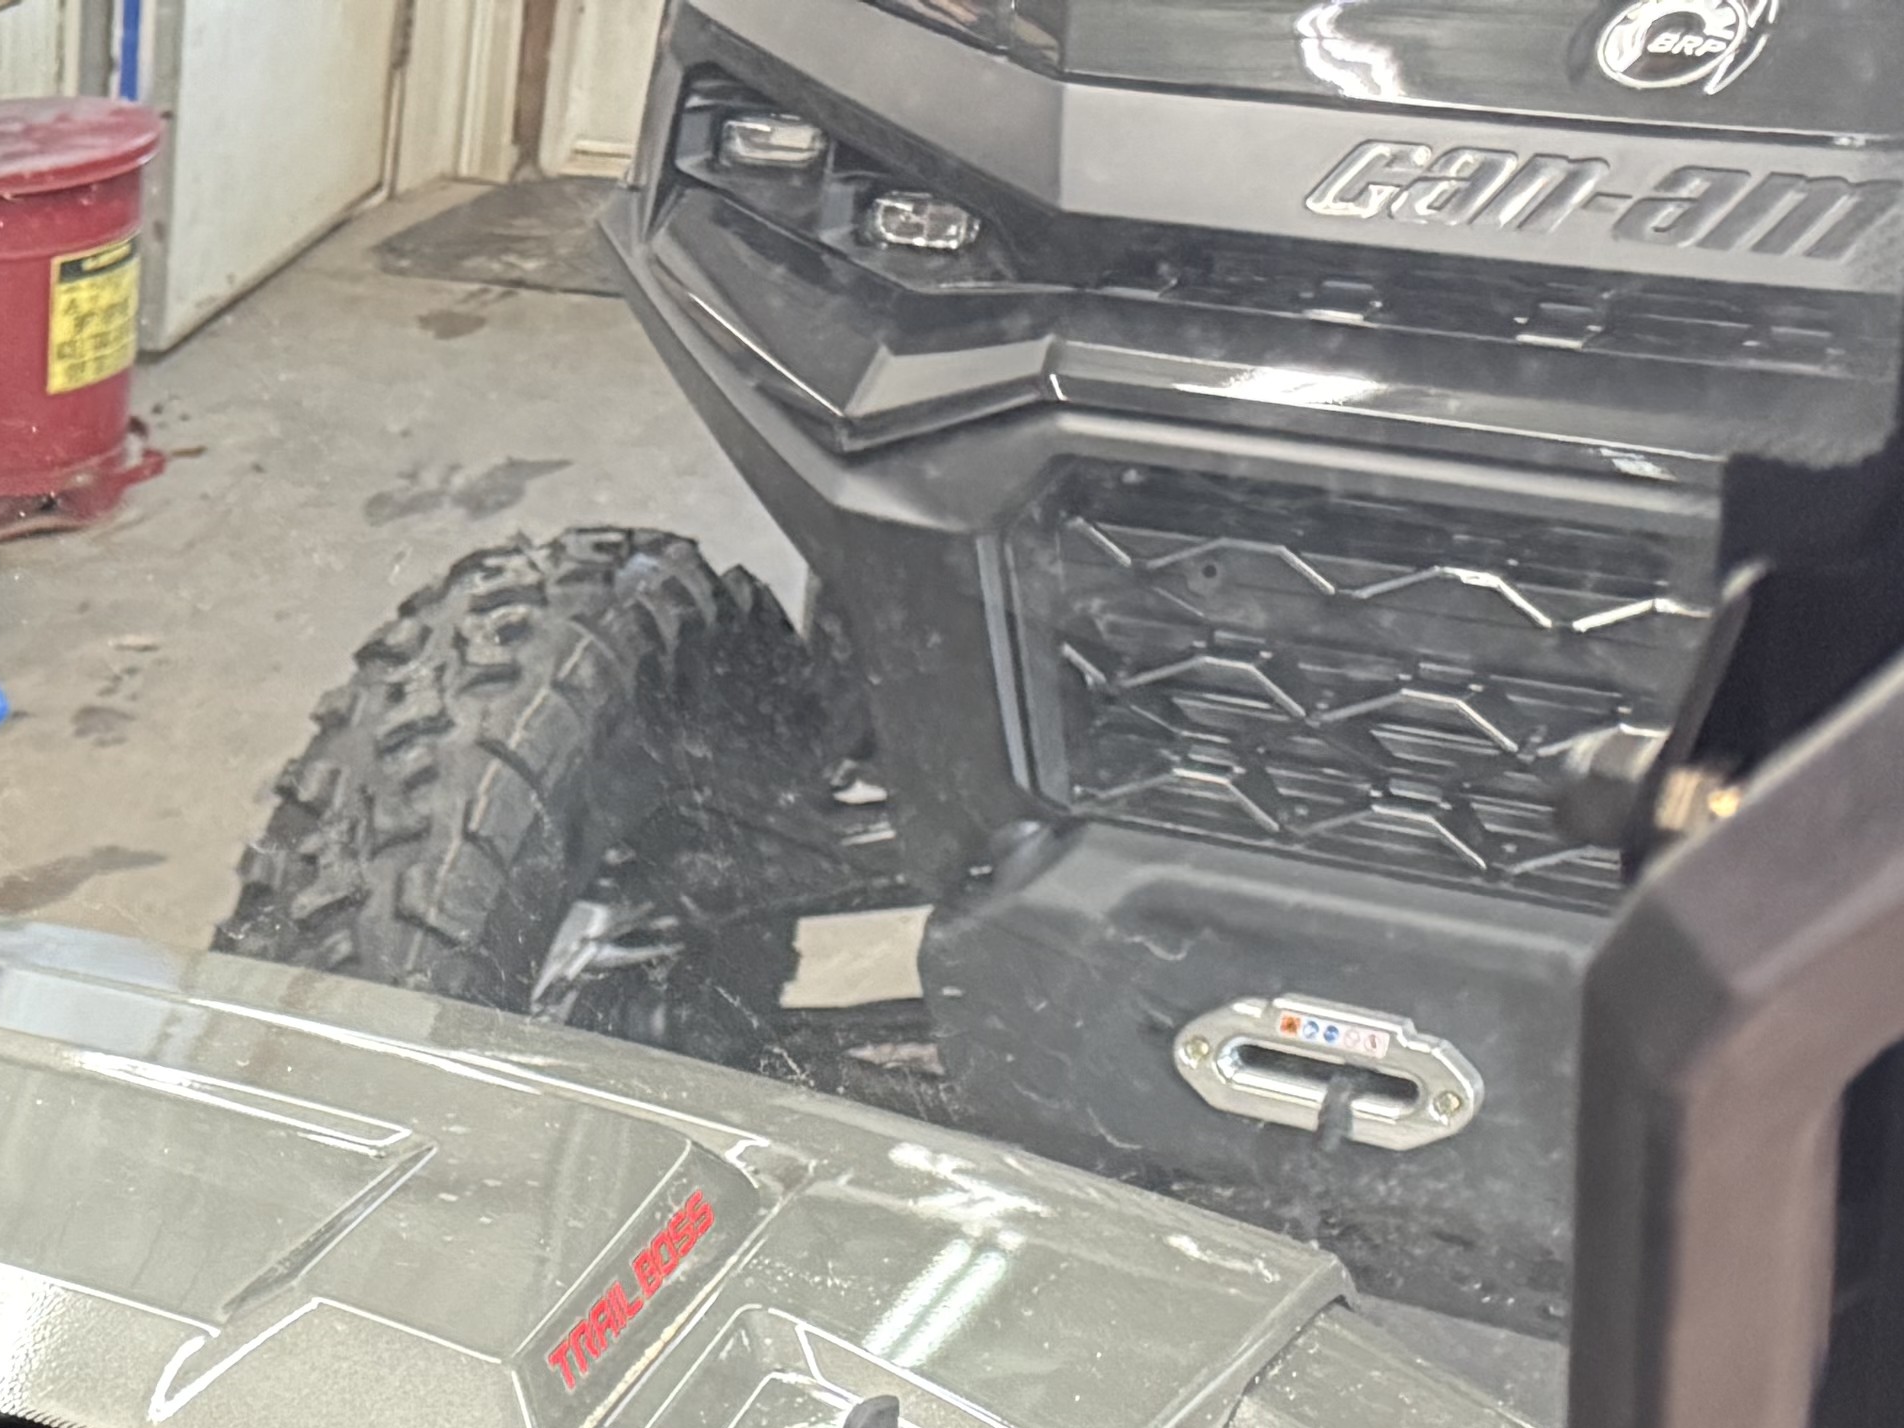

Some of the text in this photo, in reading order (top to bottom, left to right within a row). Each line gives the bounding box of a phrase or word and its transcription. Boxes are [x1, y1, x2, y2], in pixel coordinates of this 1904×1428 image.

[1648, 32, 1727, 57] BRP
[547, 1189, 715, 1391] TRAIL BOSS
